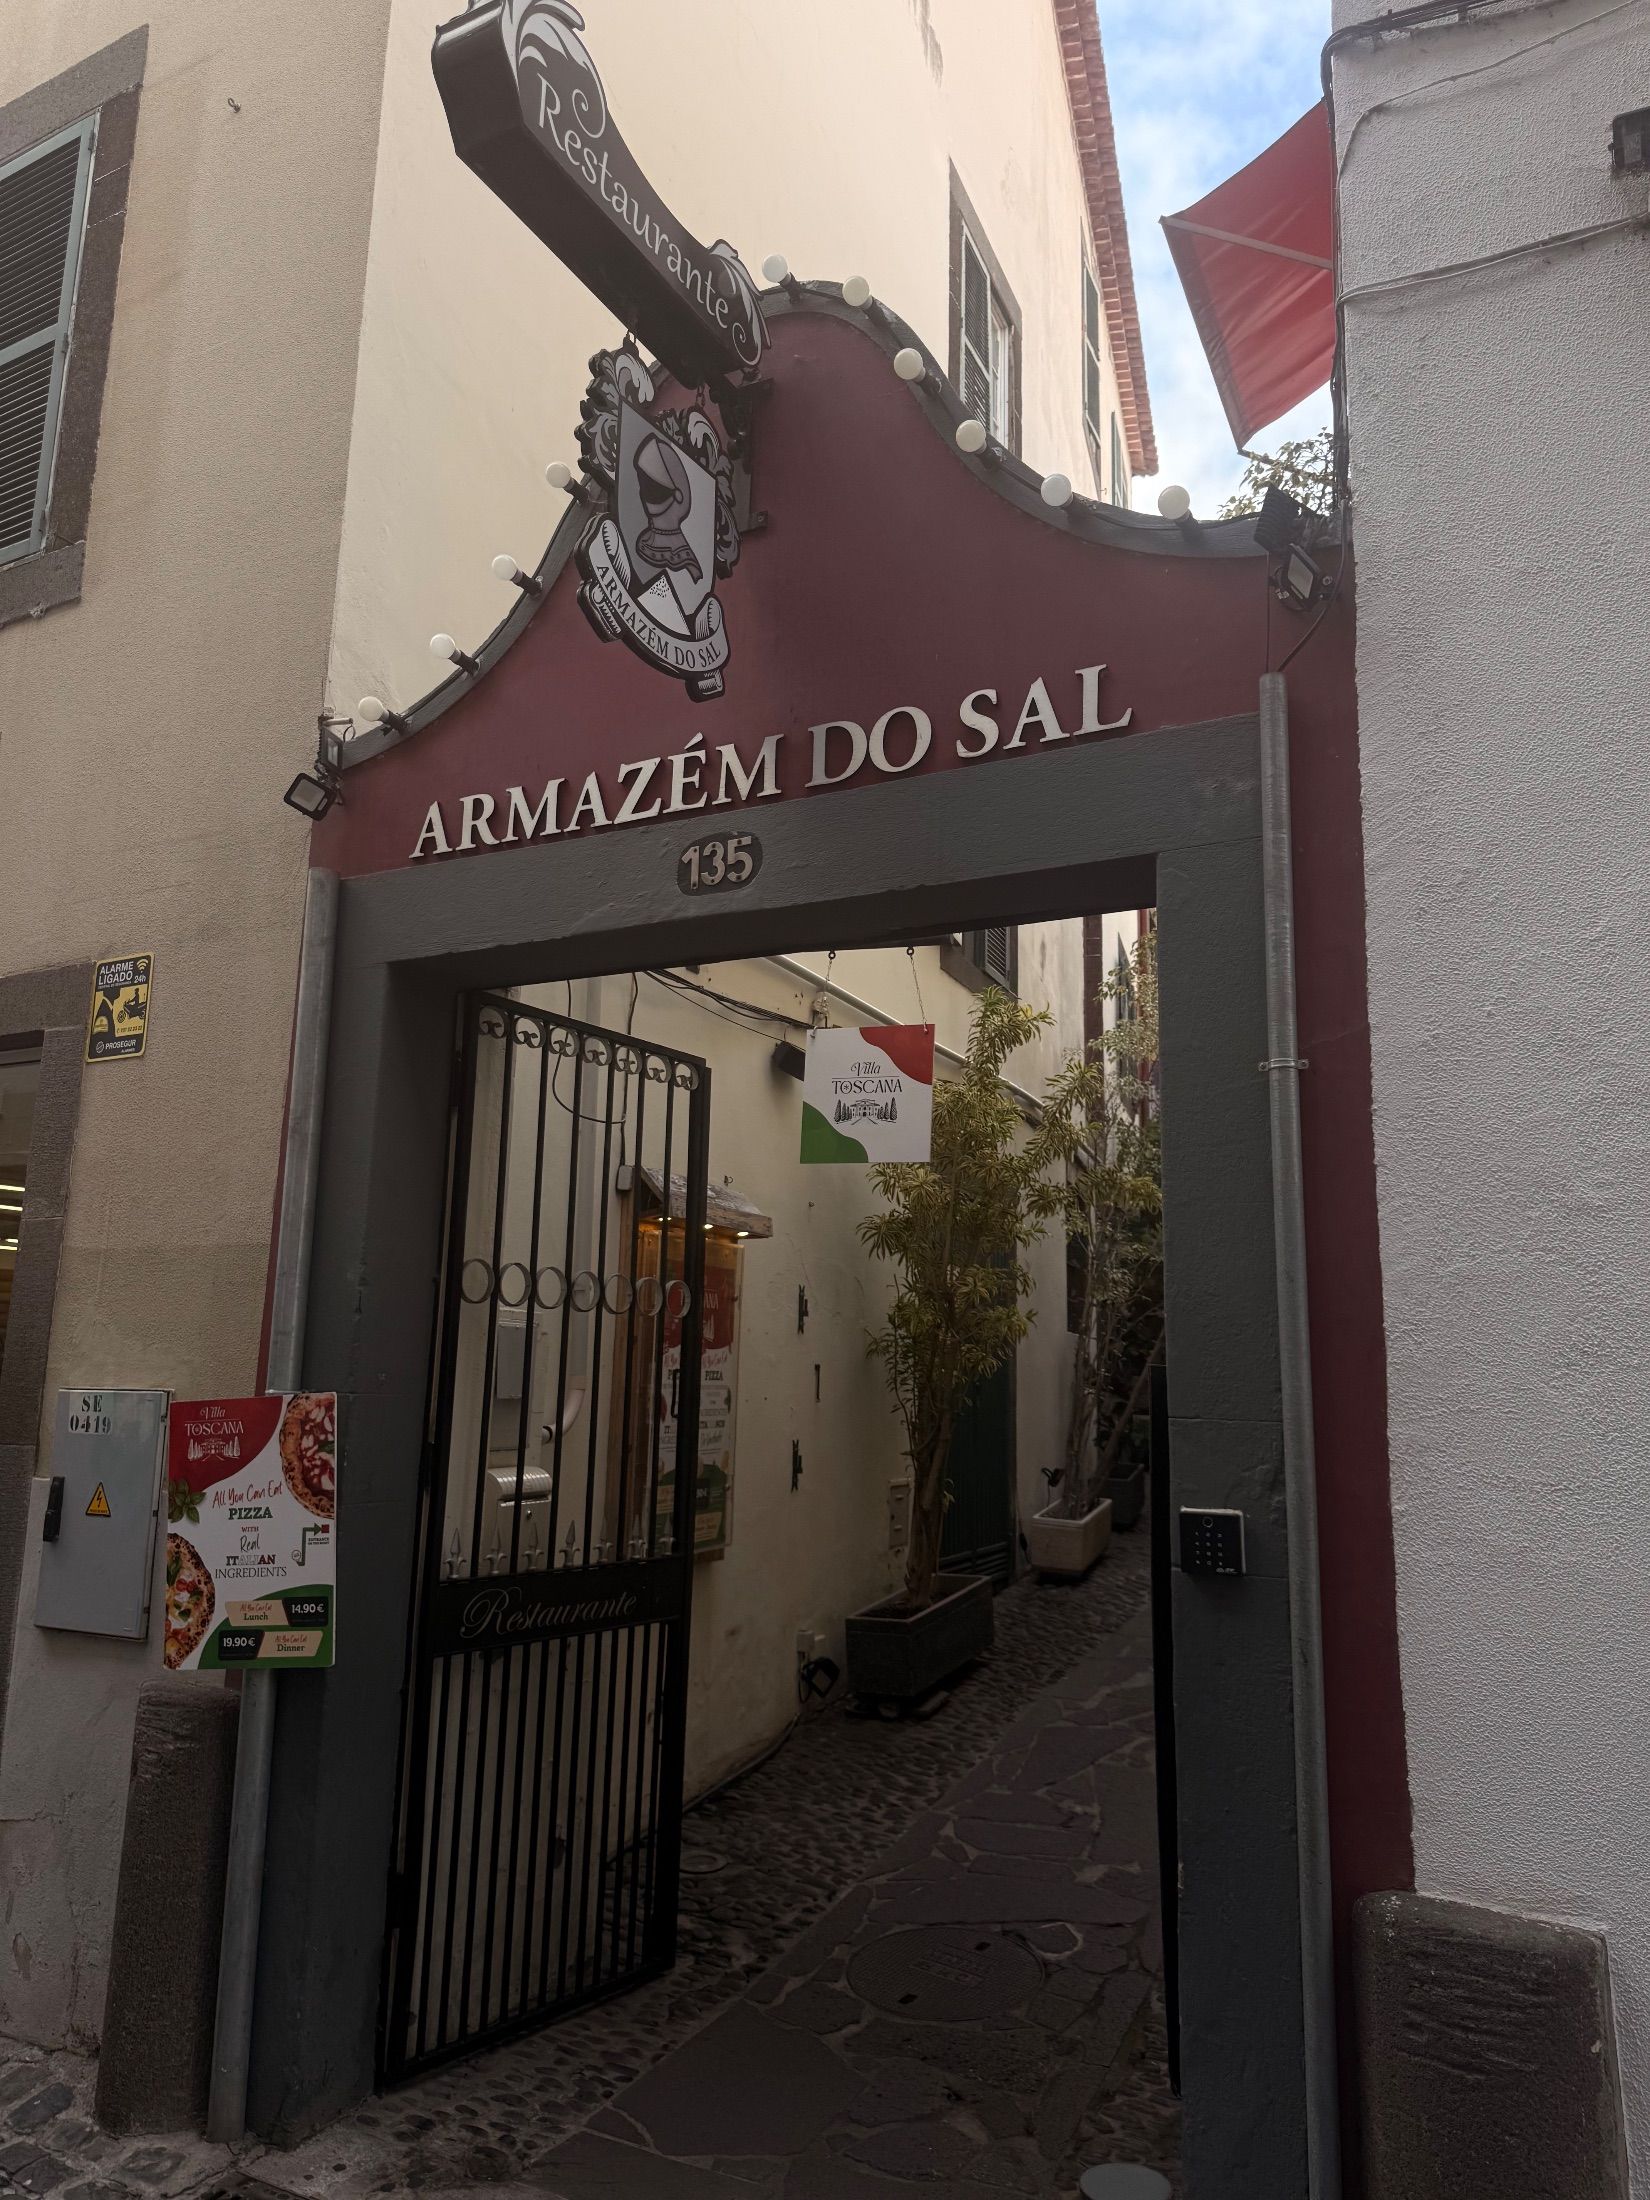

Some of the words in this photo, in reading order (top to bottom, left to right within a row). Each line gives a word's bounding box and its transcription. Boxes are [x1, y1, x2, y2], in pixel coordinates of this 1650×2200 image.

[537, 73, 729, 328] Restaurante
[597, 565, 669, 660] ARMAZÉM
[674, 646, 696, 669] DO
[699, 642, 721, 668] SAL
[408, 732, 785, 860] ARMAZÉM
[804, 705, 934, 790] DO
[954, 663, 1135, 761] SAL
[681, 835, 754, 890] 135
[99, 961, 134, 975] ALARME
[98, 971, 133, 986] LIGADO
[134, 975, 147, 984] 24h
[105, 1039, 137, 1050] PROSEGUR
[850, 1061, 881, 1076] Villa
[831, 1078, 903, 1095] TOSCANA
[81, 1394, 103, 1413] SE
[200, 1405, 226, 1420] Villa
[69, 1414, 112, 1434] 0419
[184, 1421, 244, 1436] TOSCANA
[212, 1489, 226, 1508] All
[228, 1487, 244, 1505] You
[246, 1483, 266, 1502] Can
[228, 1506, 274, 1520] PIZZA
[240, 1533, 261, 1553] Real
[226, 1554, 277, 1566] ITALIAN
[215, 1566, 287, 1579] INGREDIENTS
[243, 1612, 269, 1621] Lunch
[459, 1586, 637, 1639] Restaurante
[277, 1643, 305, 1652] Dinner
